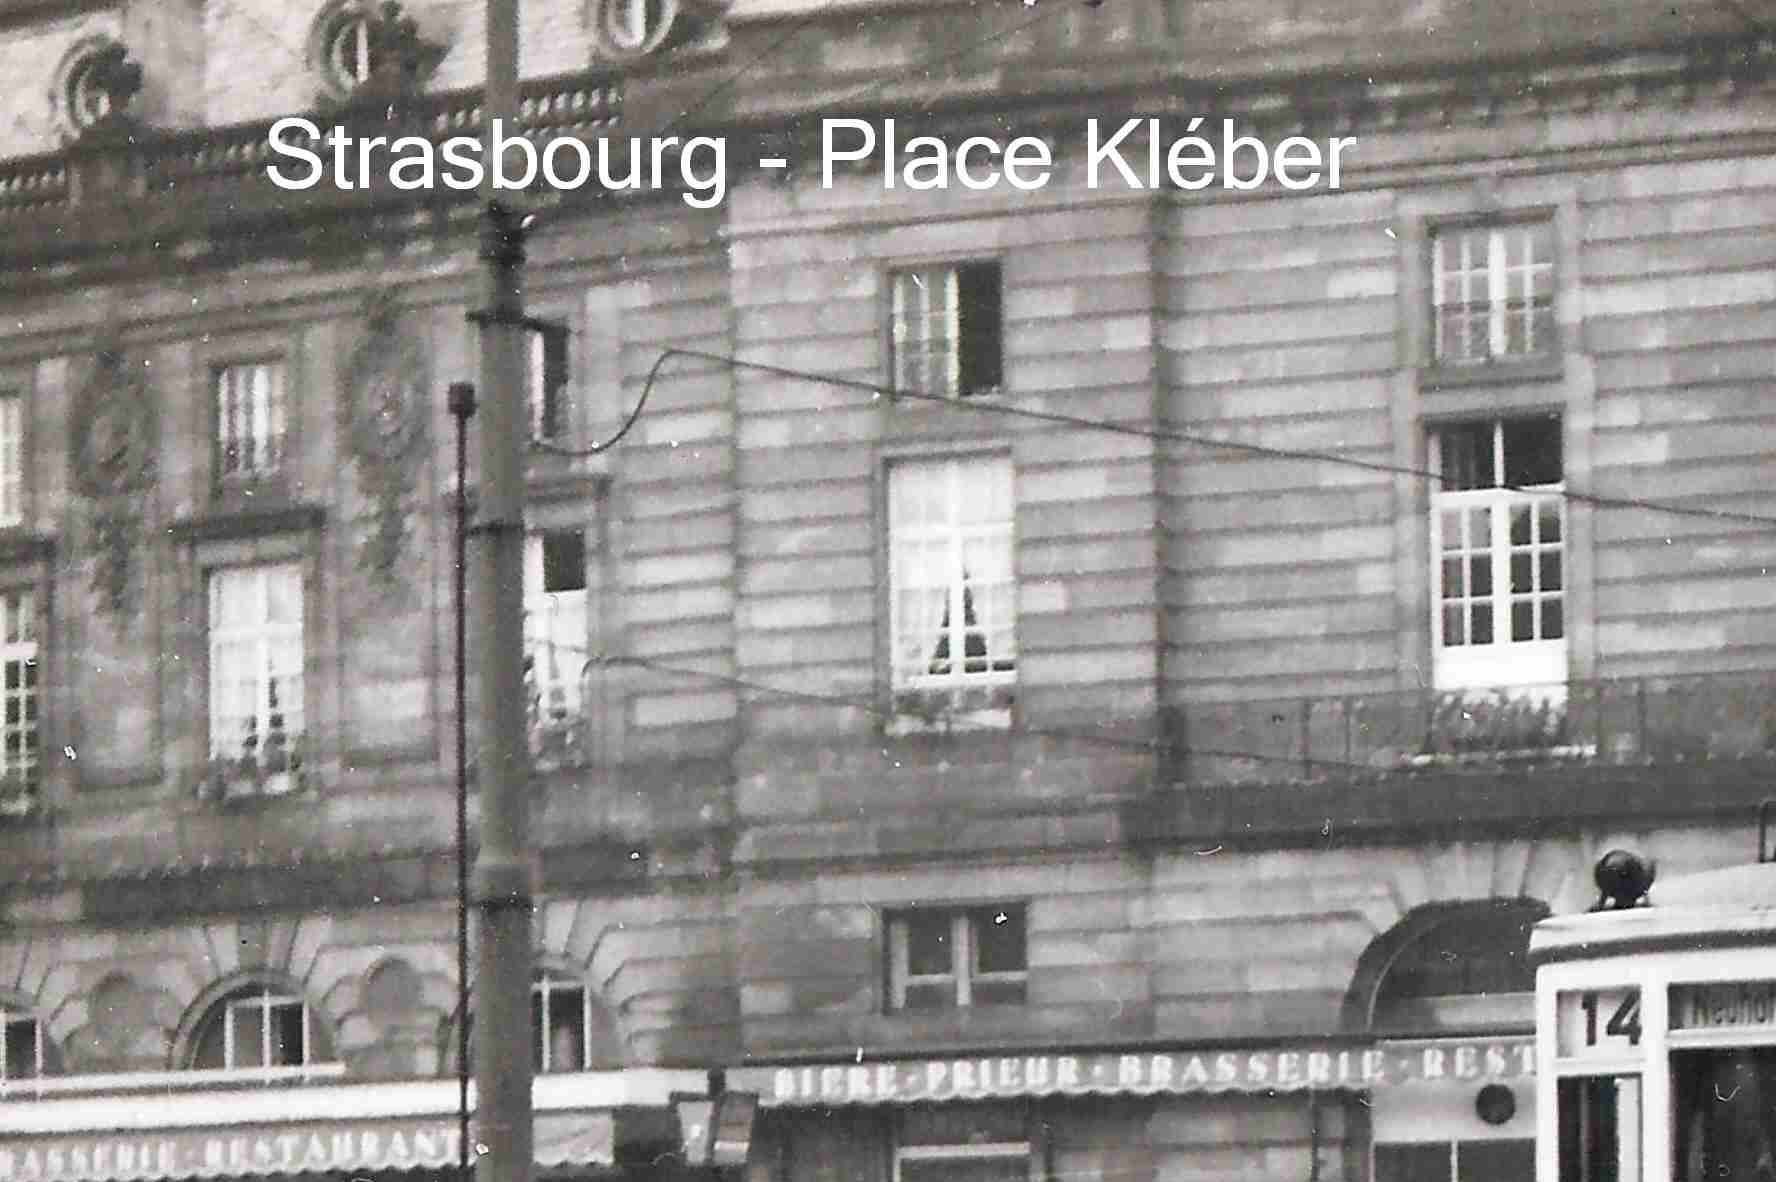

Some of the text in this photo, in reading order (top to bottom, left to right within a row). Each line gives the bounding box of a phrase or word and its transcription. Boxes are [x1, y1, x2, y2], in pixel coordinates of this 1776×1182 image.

[1582, 993, 1642, 1046] 14
[925, 1055, 1077, 1093] PRIEUR
[1119, 1048, 1385, 1086] BRASSERIE
